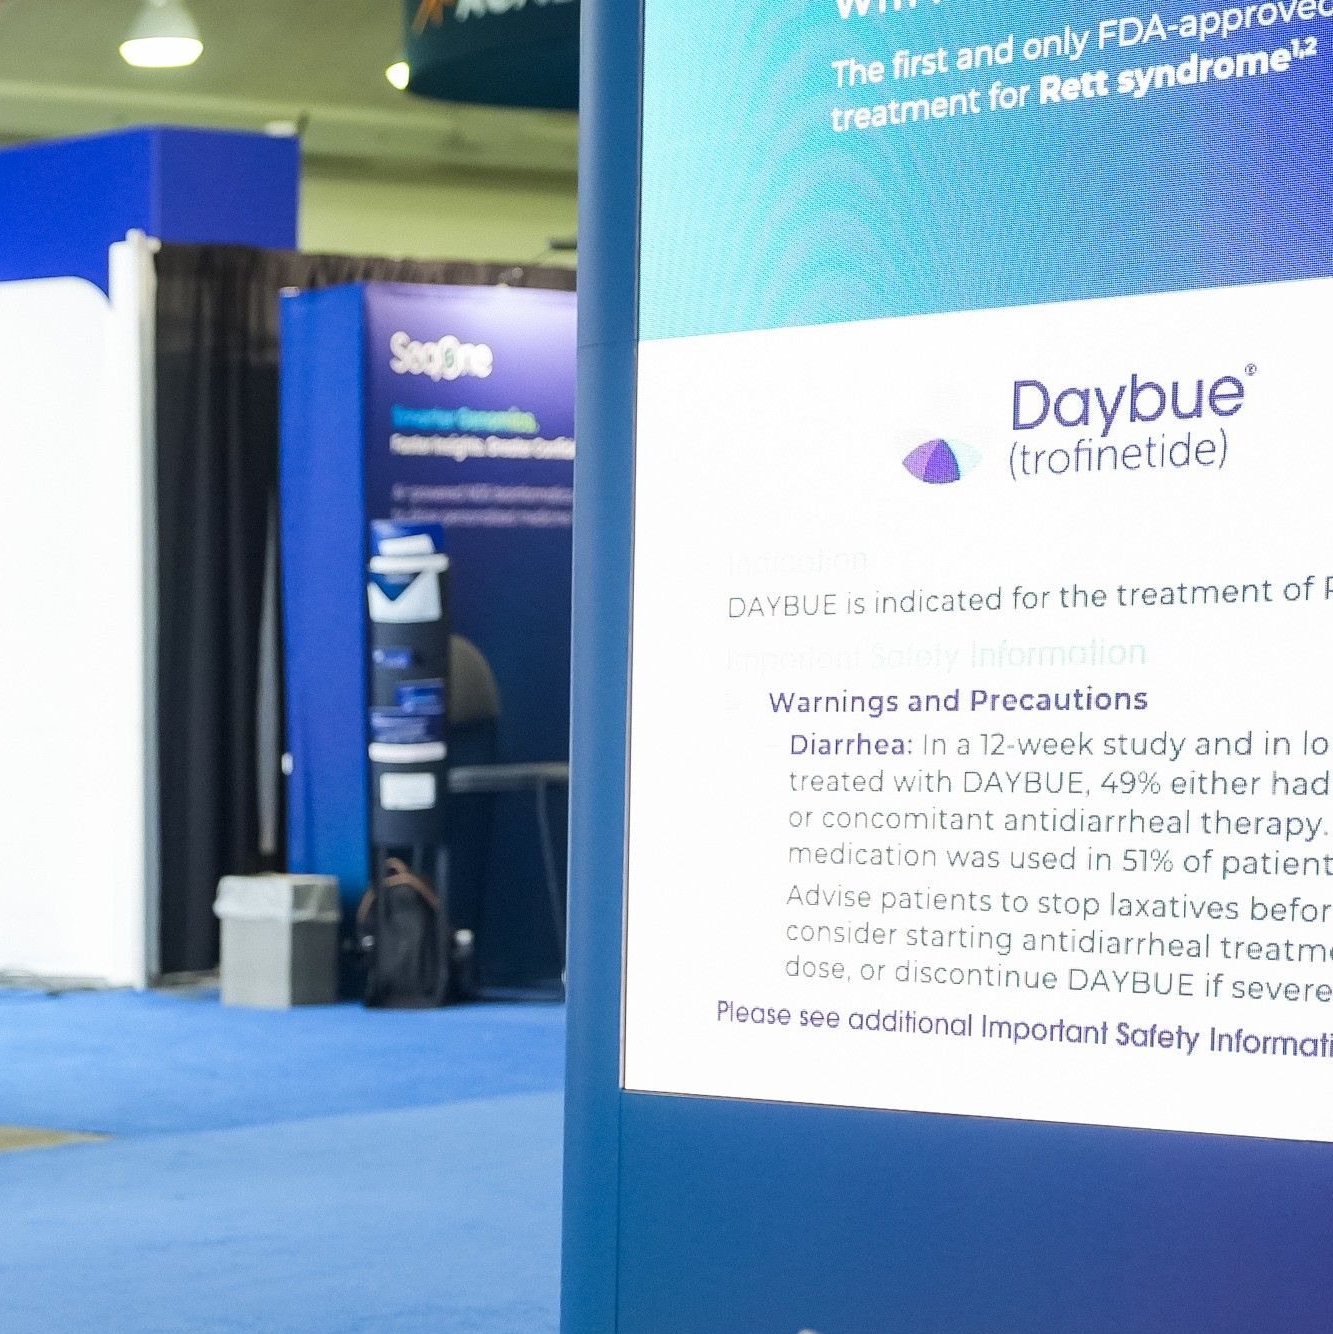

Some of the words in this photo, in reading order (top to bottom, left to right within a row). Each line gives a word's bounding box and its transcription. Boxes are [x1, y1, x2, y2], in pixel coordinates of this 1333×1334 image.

[831, 56, 885, 88] The
[892, 47, 948, 79] first
[956, 35, 1013, 70] and
[1023, 26, 1090, 61] only
[831, 85, 981, 132] treatment
[988, 80, 1029, 113] for
[1038, 69, 1110, 104] Rett
[1009, 427, 1228, 482] (trofinetide)
[728, 594, 837, 618] DAYBUE
[847, 592, 865, 614] is
[875, 586, 1002, 613] indicated
[1013, 585, 1050, 609] for
[1060, 584, 1107, 607] the
[1117, 582, 1273, 606] treatment
[1283, 575, 1315, 601] of
[769, 689, 898, 717] Warnings
[908, 689, 959, 711] and
[971, 685, 1148, 712] Precautions
[790, 732, 912, 755] Diarrhea:
[924, 734, 946, 755] In
[957, 738, 970, 755] a
[980, 731, 1093, 756] 12-week
[1104, 731, 1186, 761] study
[1196, 730, 1251, 755] and
[1265, 730, 1290, 755] in
[789, 769, 884, 792] treated
[894, 769, 952, 793] with
[964, 771, 1090, 797] DAYBUE,
[1100, 770, 1161, 794] 49%
[1172, 770, 1261, 795] either
[1272, 770, 1329, 795] had
[789, 810, 813, 827] or
[822, 806, 994, 831] concomitant
[1004, 808, 1190, 834] antidiarrheal
[1201, 809, 1329, 842] therapy.
[788, 842, 936, 867] medication
[946, 850, 1000, 868] was
[1010, 846, 1075, 870] used
[1088, 846, 1111, 871] in
[1123, 848, 1173, 873] 51%
[1183, 848, 1213, 874] of
[786, 884, 872, 907] Advise
[882, 886, 992, 914] patients
[1001, 890, 1029, 913] to
[1038, 893, 1100, 921] stop
[1110, 892, 1239, 920] laxatives
[786, 921, 897, 945] consider
[906, 924, 1012, 956] starting
[1023, 929, 1209, 959] antidiarrheal
[785, 955, 851, 983] dose,
[860, 963, 886, 981] or
[895, 960, 1057, 989] discontinue
[1069, 968, 1194, 998] DAYBUE
[1205, 972, 1225, 999] if
[1232, 981, 1333, 1003] severe
[717, 999, 792, 1027] Please
[800, 1010, 840, 1029] see
[849, 1009, 972, 1038] additional
[983, 1014, 1108, 1045] Important
[1116, 1021, 1200, 1056] Safety
